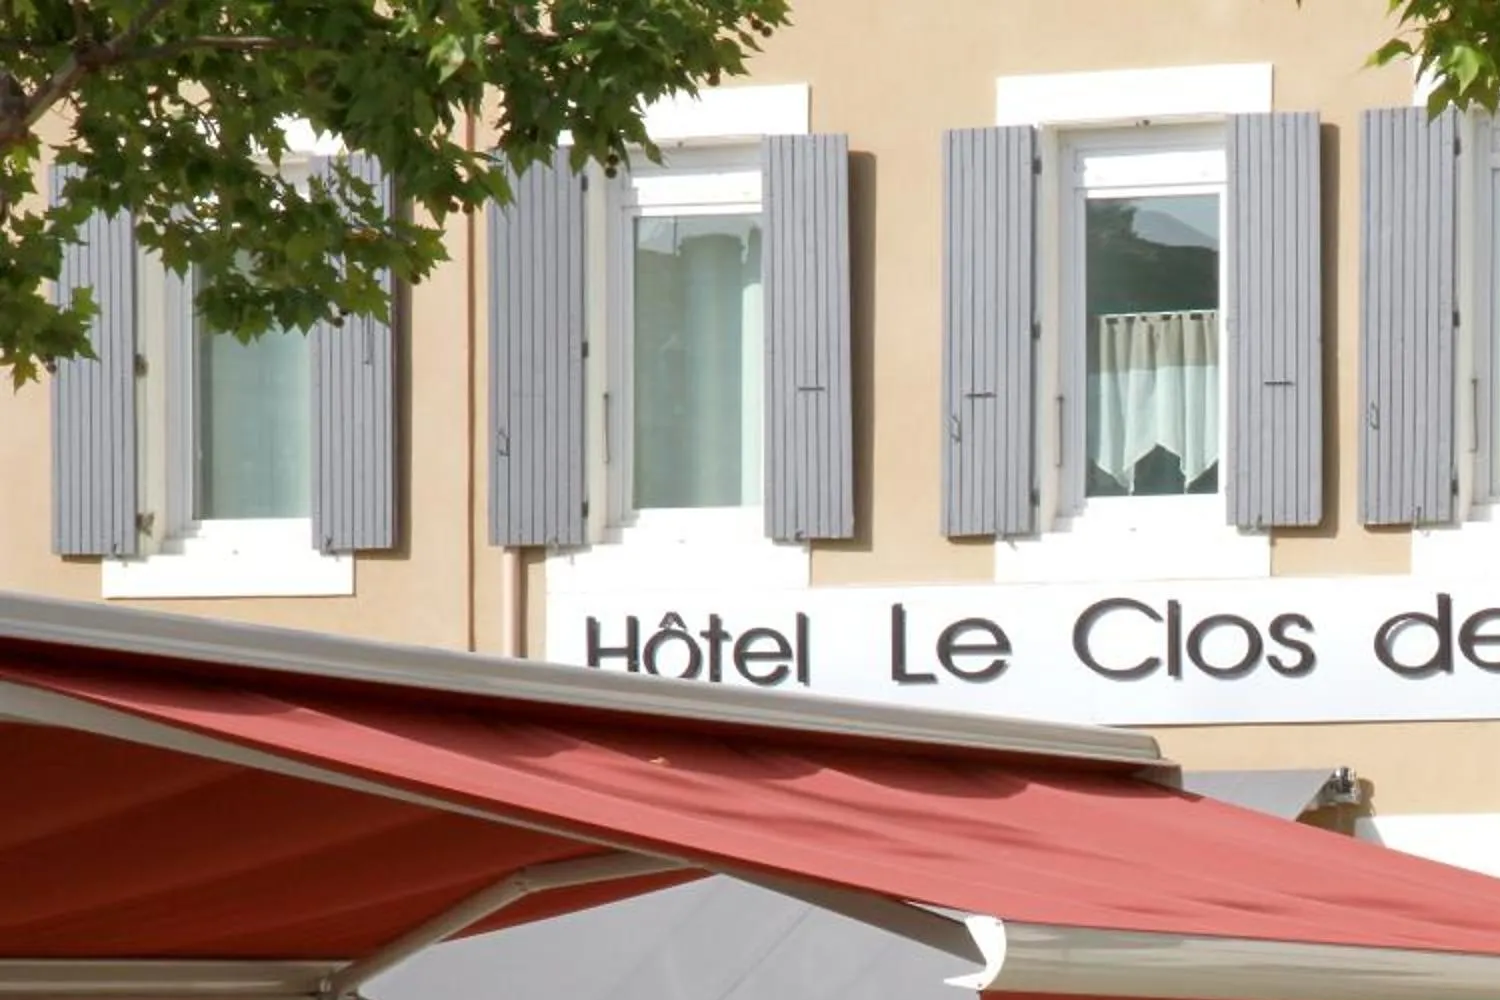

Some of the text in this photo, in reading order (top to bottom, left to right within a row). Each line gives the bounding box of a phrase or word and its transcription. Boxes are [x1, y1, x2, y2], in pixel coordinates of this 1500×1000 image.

[586, 611, 811, 687] Hôtel
[892, 604, 1013, 684] Le
[1072, 597, 1317, 680] Clos
